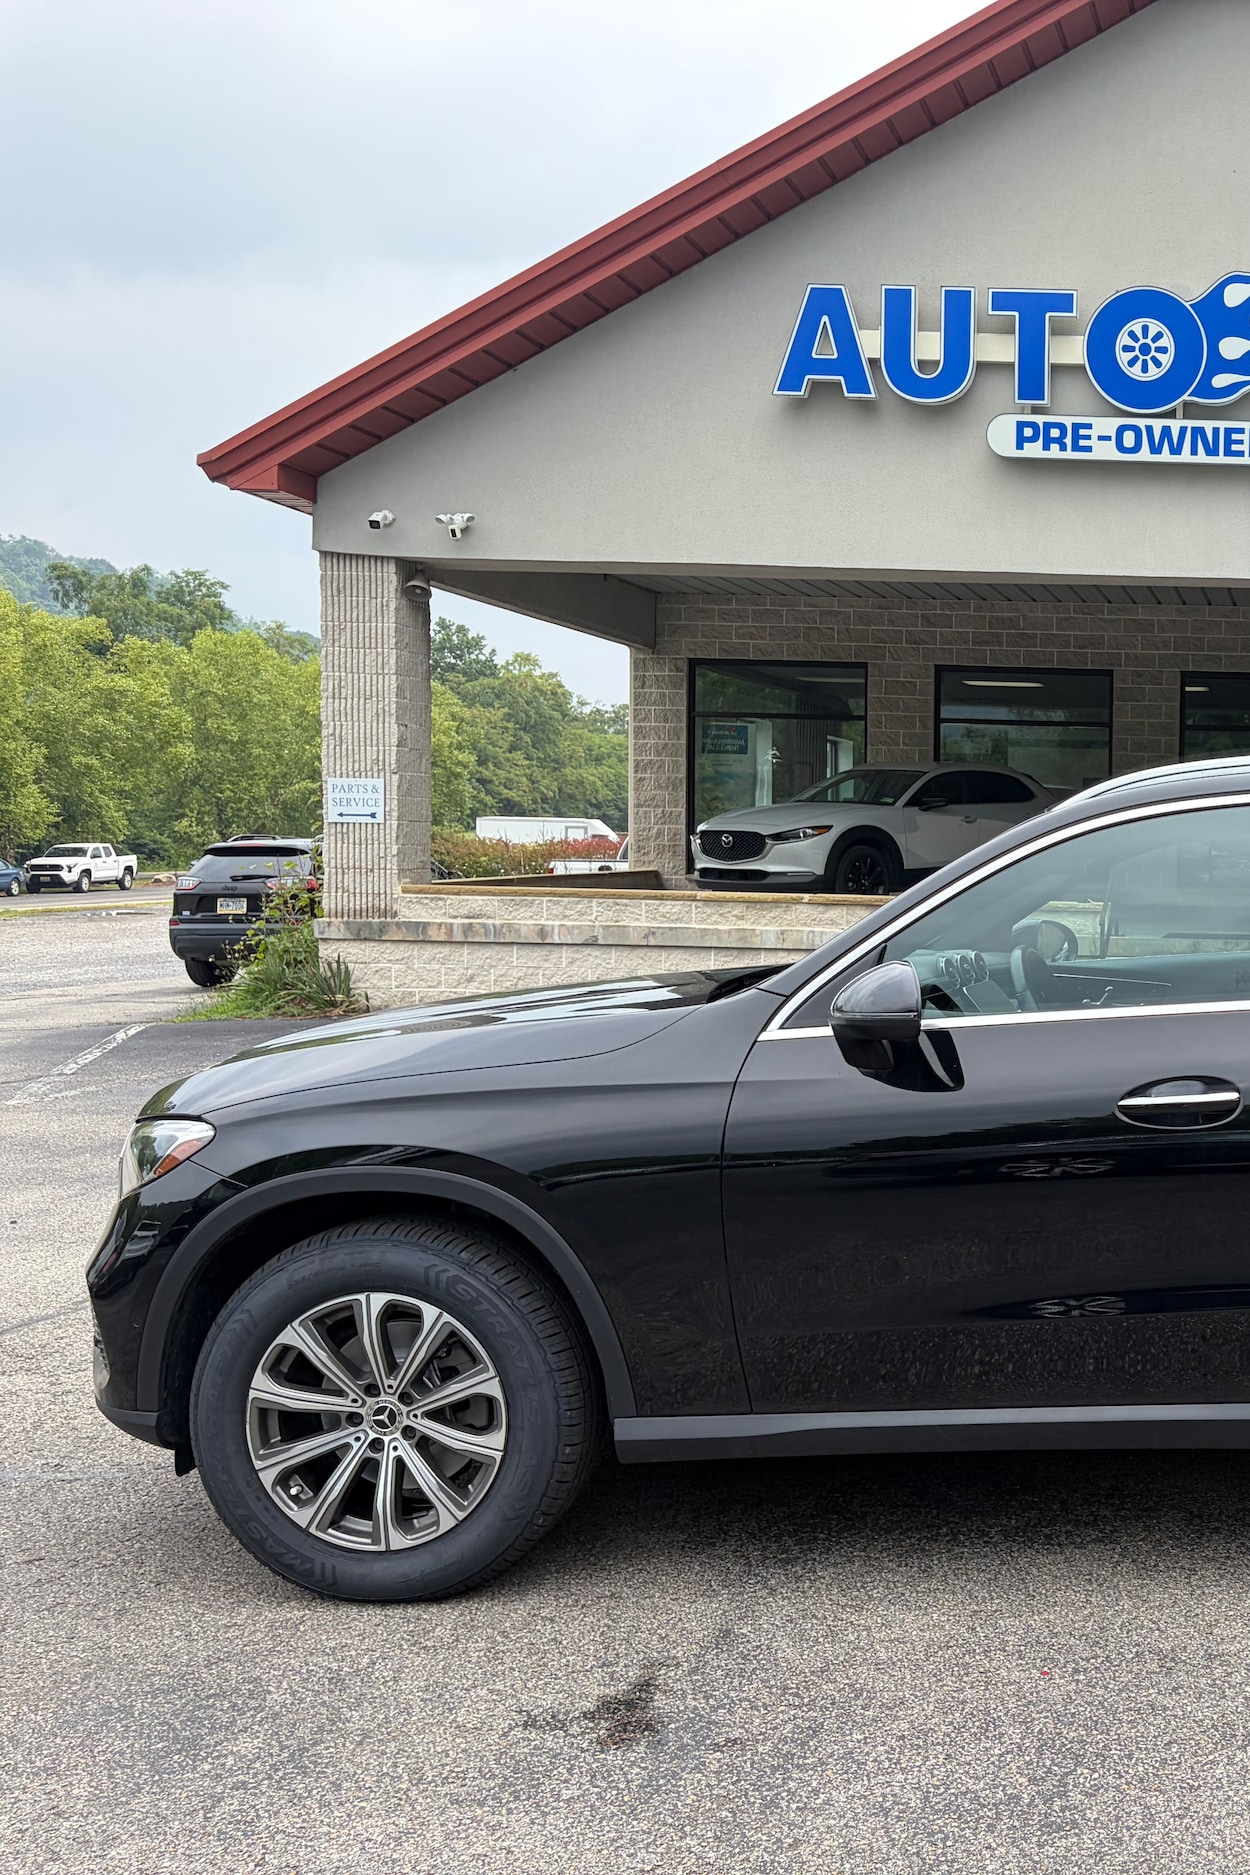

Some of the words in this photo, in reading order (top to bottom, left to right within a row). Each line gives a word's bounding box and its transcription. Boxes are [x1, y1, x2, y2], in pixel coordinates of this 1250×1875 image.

[772, 283, 1207, 414] AUTO
[331, 783, 368, 794] PARTS
[370, 783, 380, 794] &
[331, 797, 381, 808] SERVICE
